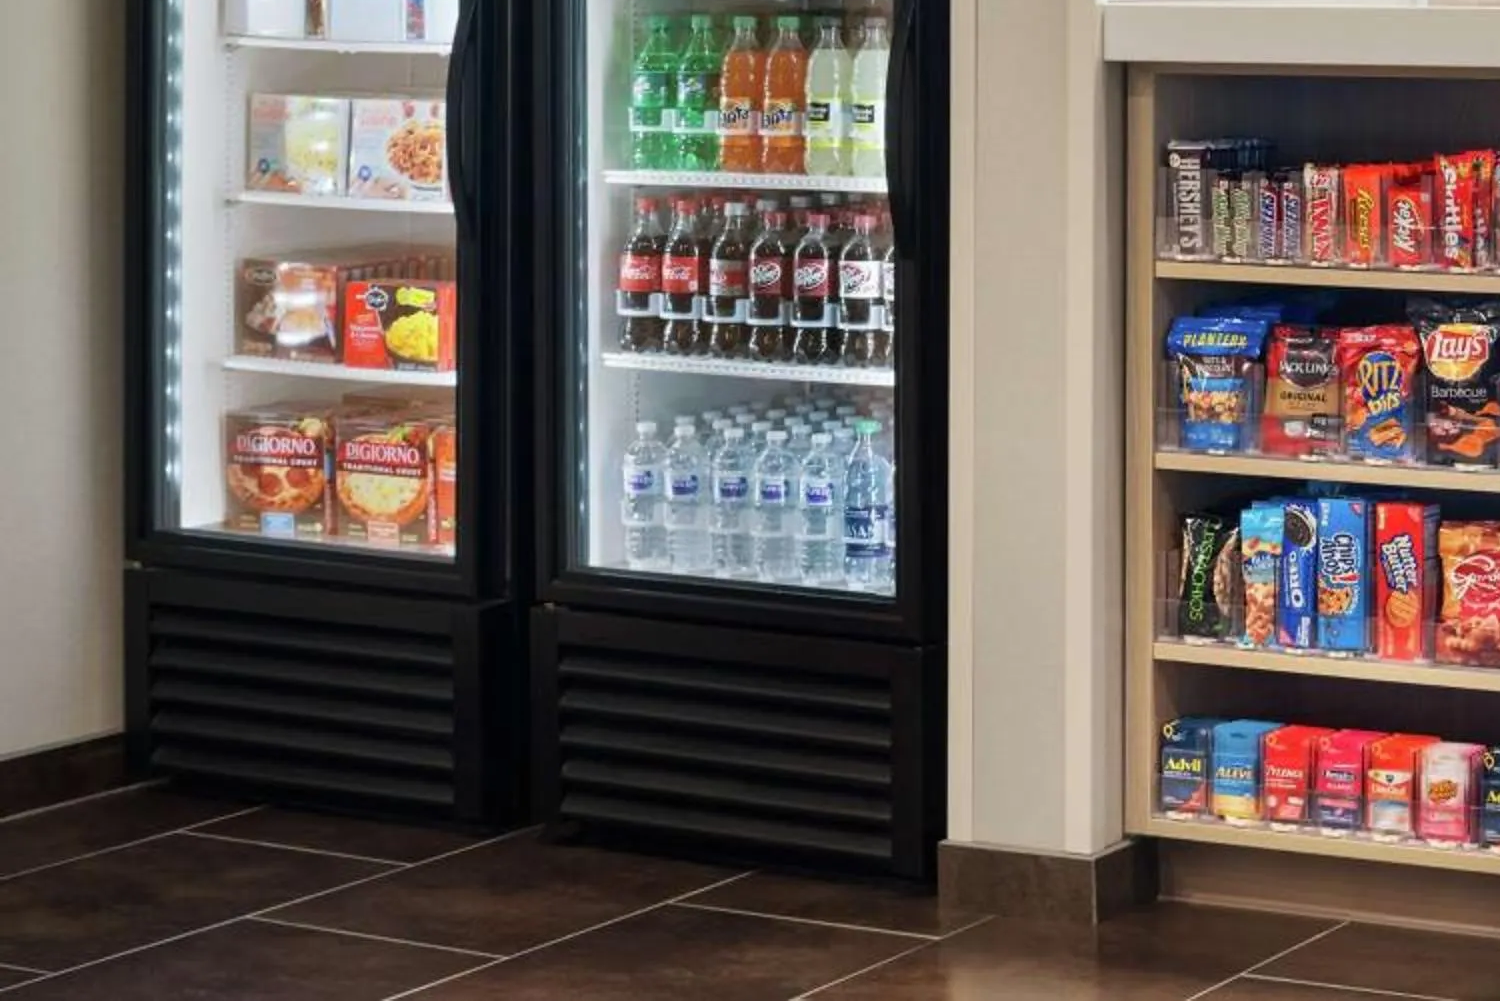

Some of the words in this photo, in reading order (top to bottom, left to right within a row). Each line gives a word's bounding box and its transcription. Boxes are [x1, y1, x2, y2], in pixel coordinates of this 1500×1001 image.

[1178, 157, 1202, 249] HERSHEY'S
[1358, 358, 1401, 396] RITZ
[1431, 386, 1487, 399] Barbecue
[1166, 756, 1201, 772] Advil
